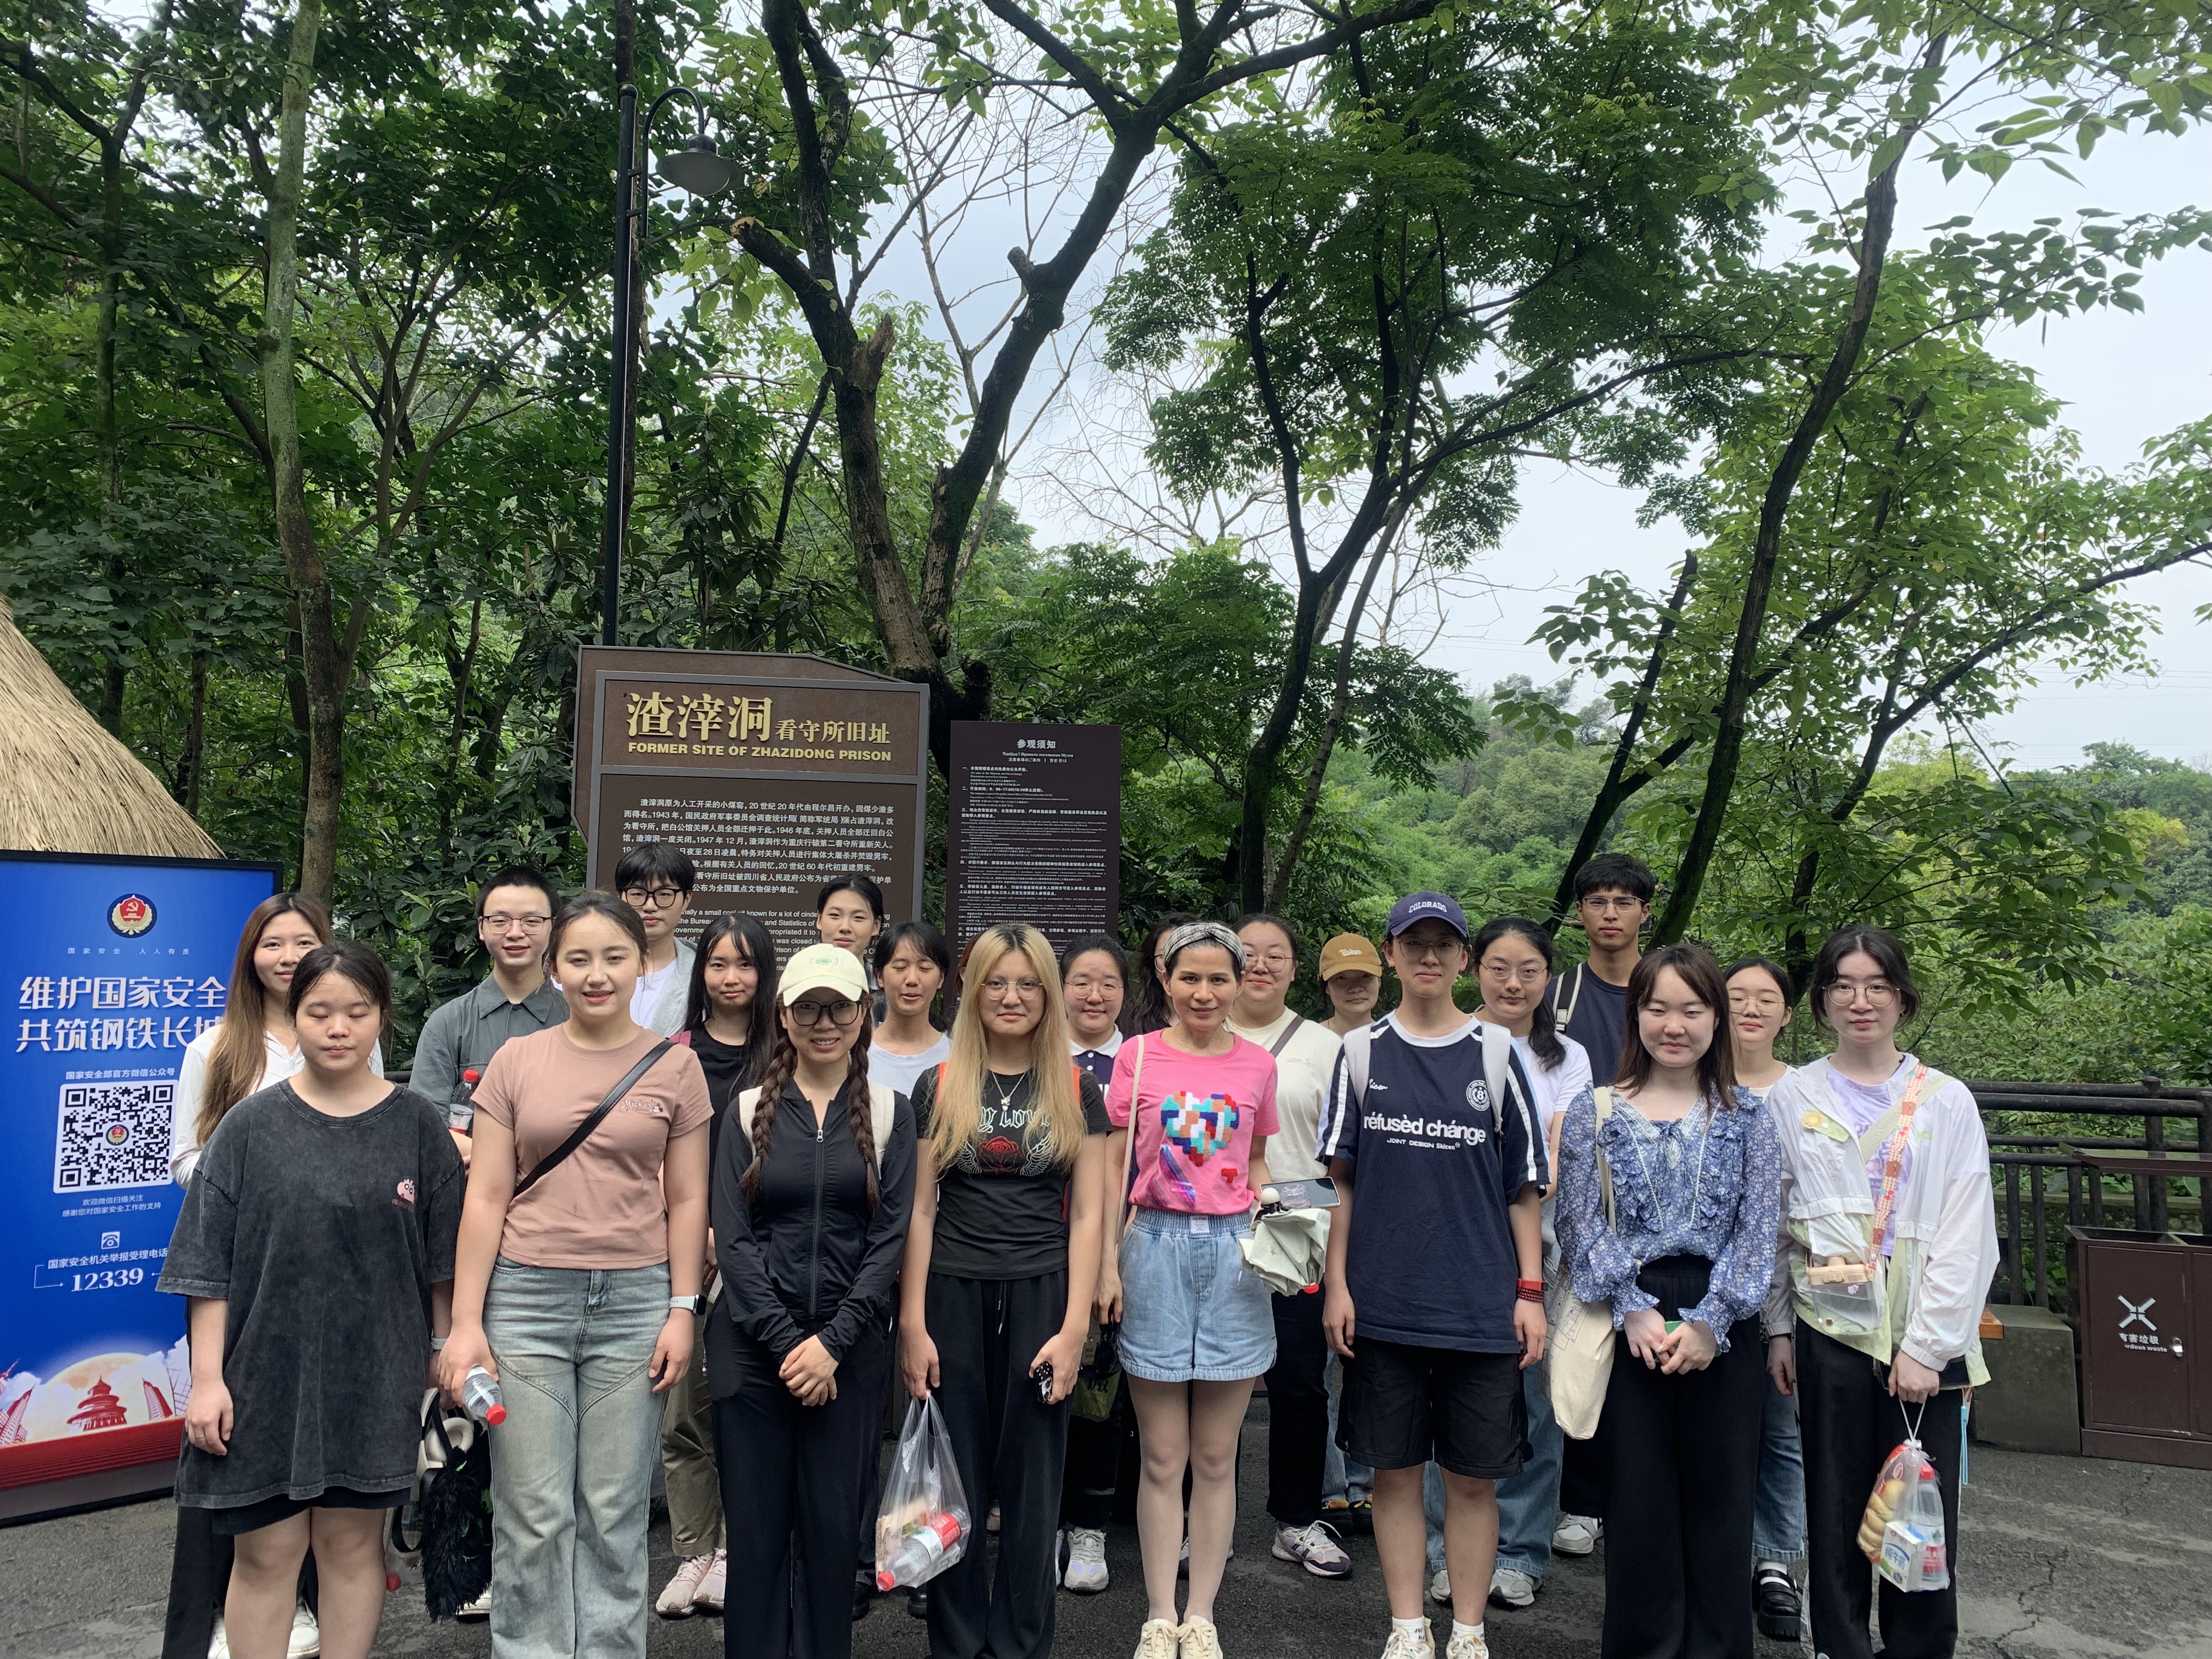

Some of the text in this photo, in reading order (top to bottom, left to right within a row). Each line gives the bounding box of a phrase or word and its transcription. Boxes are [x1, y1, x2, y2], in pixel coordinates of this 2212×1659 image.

[627, 692, 891, 744] 渣滓洞 看守所旧址
[1017, 739, 1056, 749] 参观须知
[628, 742, 891, 761] FORMER SITE OF ZHAZIDONG PRISON
[1409, 901, 1448, 913] COLORADO
[67, 947, 121, 955] 国家安全
[19, 976, 227, 1009] 维护国家安全
[66, 1068, 175, 1080] 国家安全部官方微信公众号
[1364, 1111, 1486, 1146] réfusèd chánge
[1409, 1140, 1435, 1148] DESIGN
[1436, 1142, 1455, 1150] Skicen
[82, 1194, 144, 1206] 欢迎微信扫描关注
[62, 1202, 162, 1217] 感谢您对国家安全工作的支持
[48, 1248, 168, 1269] 国家安全机关举报受理电话
[71, 1267, 144, 1292] 12339
[2119, 1332, 2159, 1345] 有害垃圾
